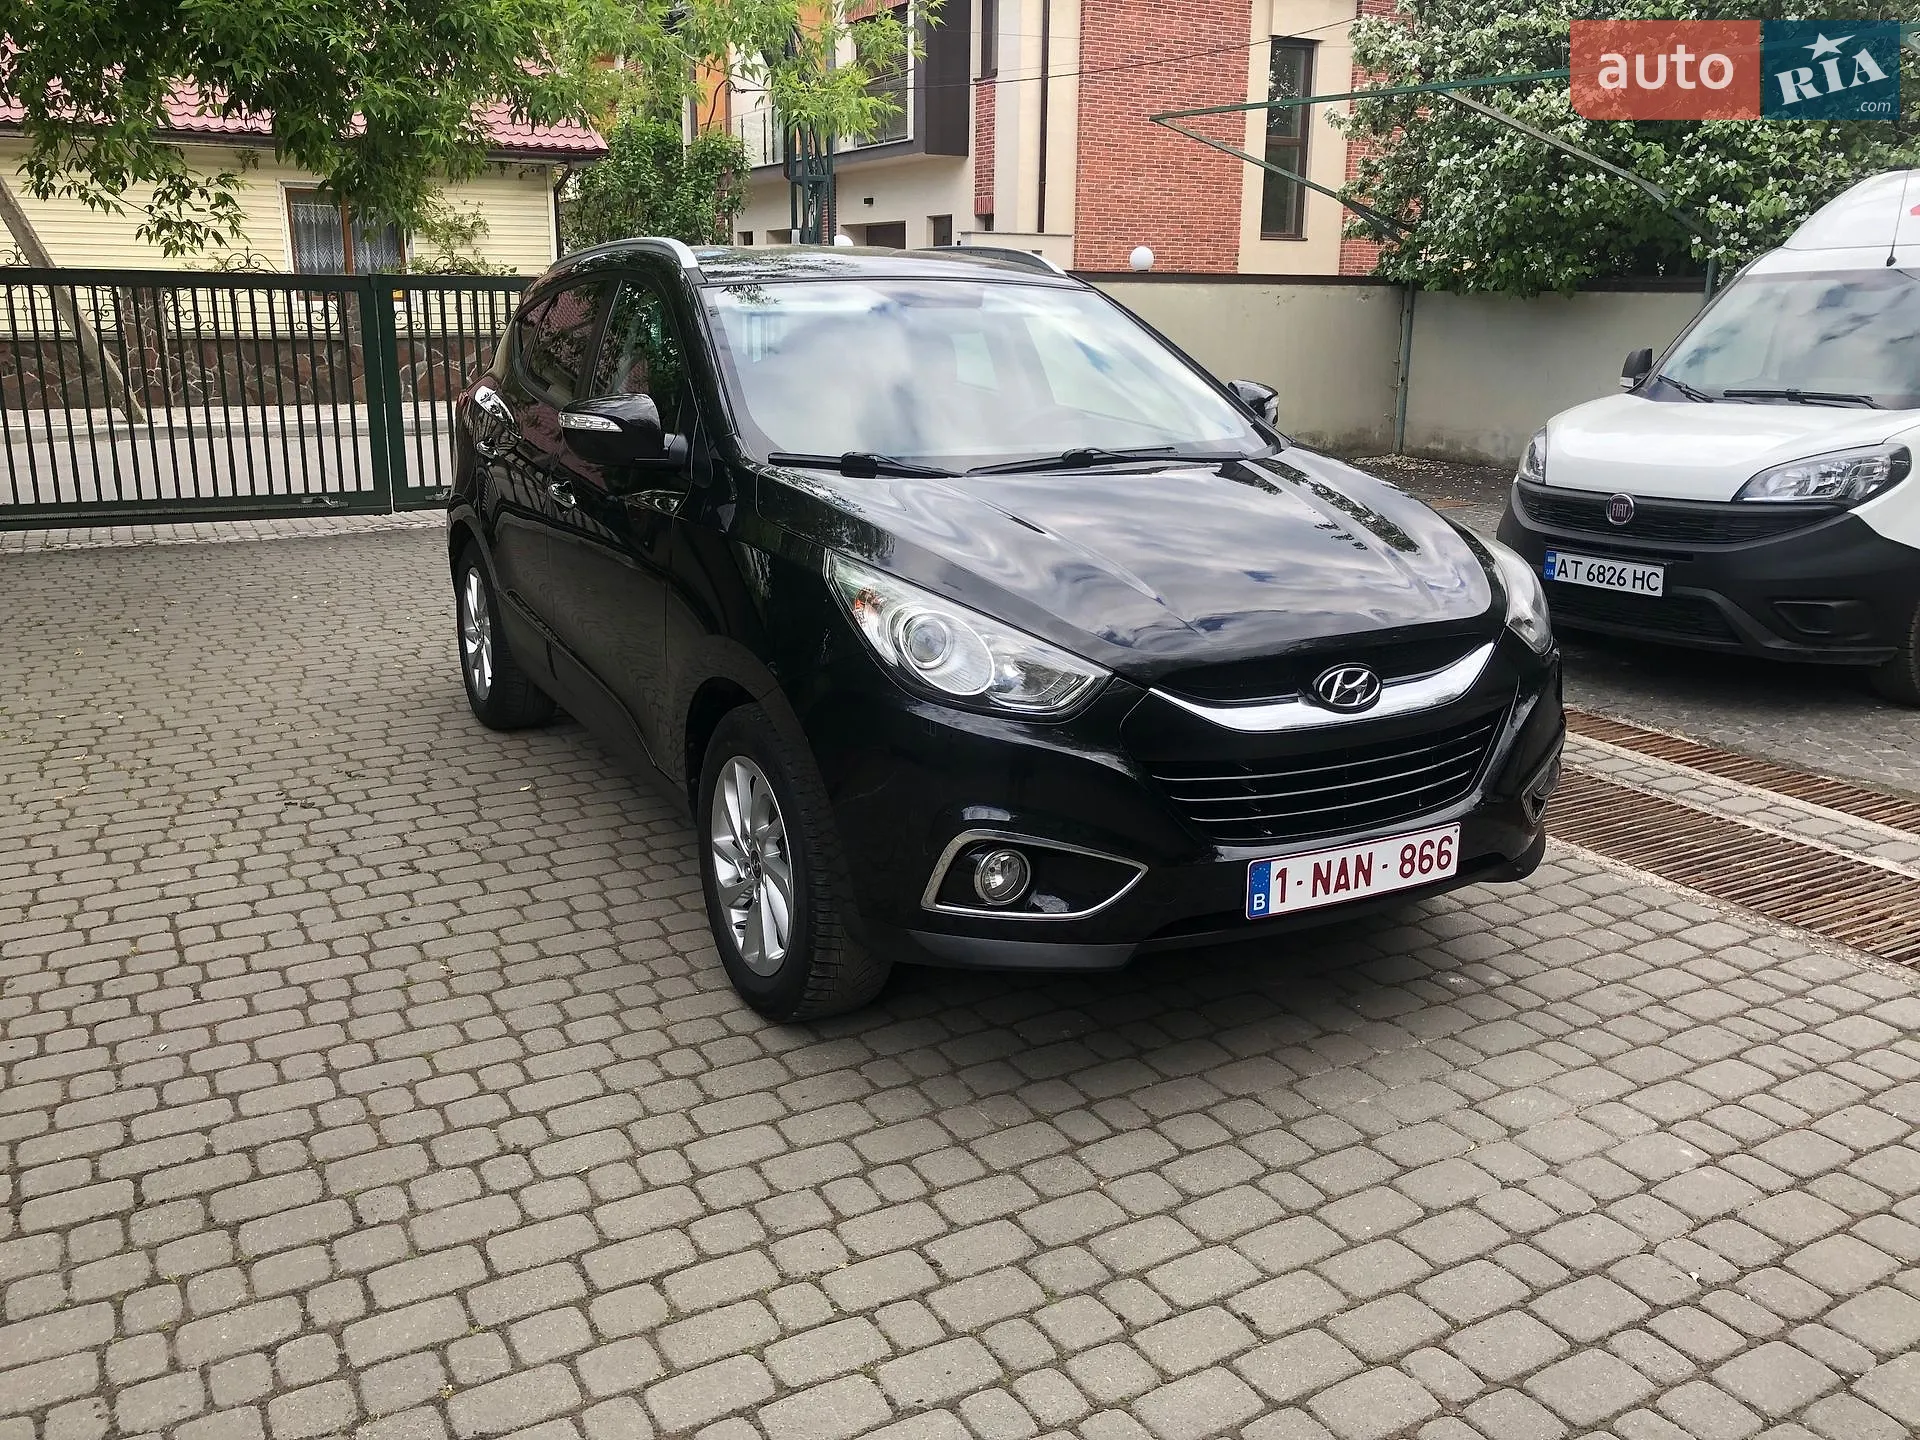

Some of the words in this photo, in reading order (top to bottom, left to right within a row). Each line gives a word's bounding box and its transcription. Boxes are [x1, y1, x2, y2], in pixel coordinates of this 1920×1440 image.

[1612, 503, 1628, 517] FIAT
[1556, 558, 1583, 580] AT
[1586, 563, 1627, 587] 6826
[1632, 569, 1660, 592] HC
[1252, 893, 1266, 911] B
